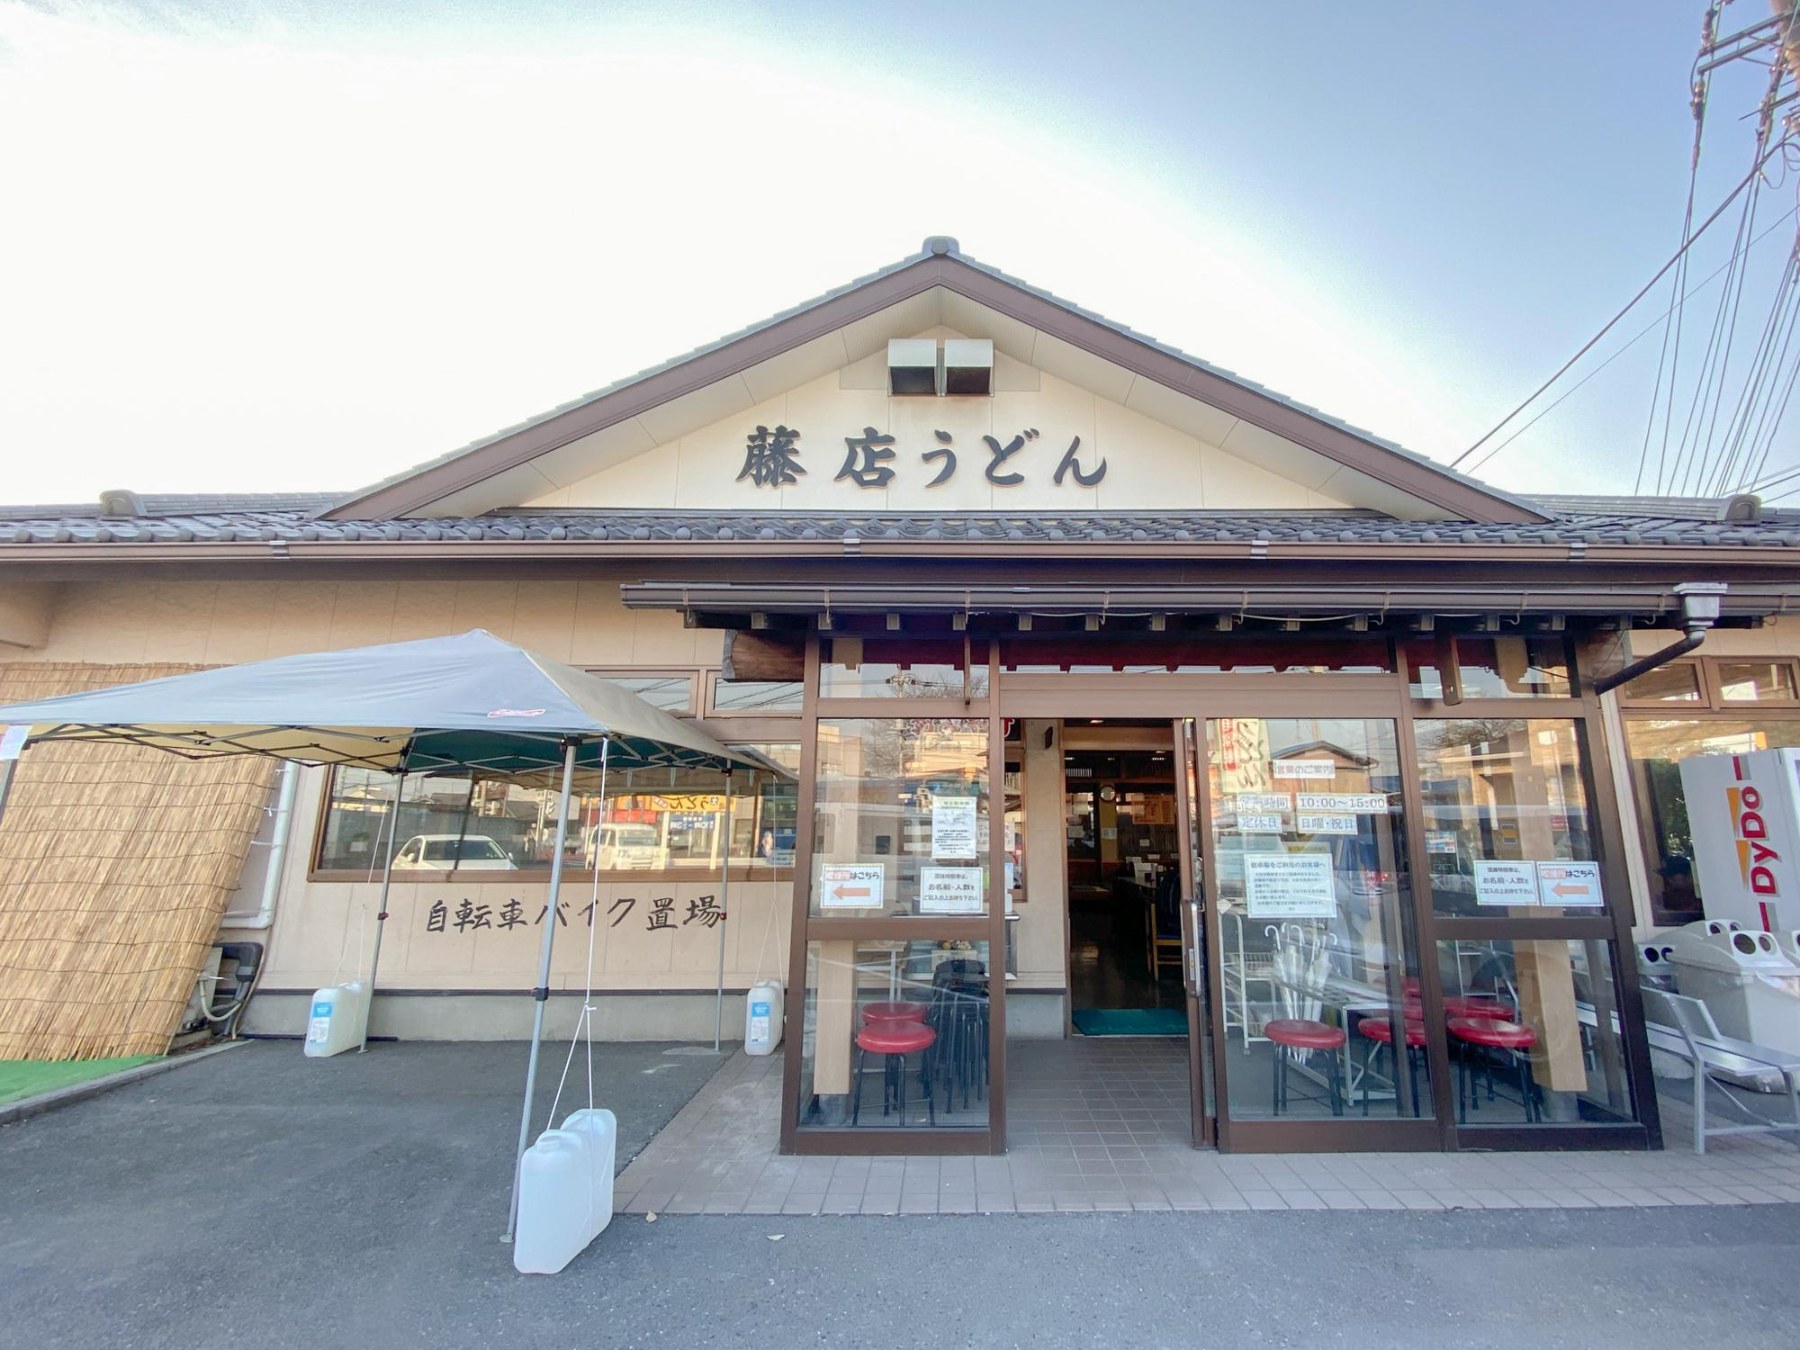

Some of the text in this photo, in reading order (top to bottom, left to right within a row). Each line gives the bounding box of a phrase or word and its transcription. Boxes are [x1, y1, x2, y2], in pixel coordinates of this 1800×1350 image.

[735, 425, 1108, 488] 藤店うどん
[1277, 764, 1333, 775] 営業のご案内
[1241, 815, 1278, 829] 定休日
[1739, 786, 1780, 895] DyDo
[426, 894, 723, 934] 自転車バイク置場
